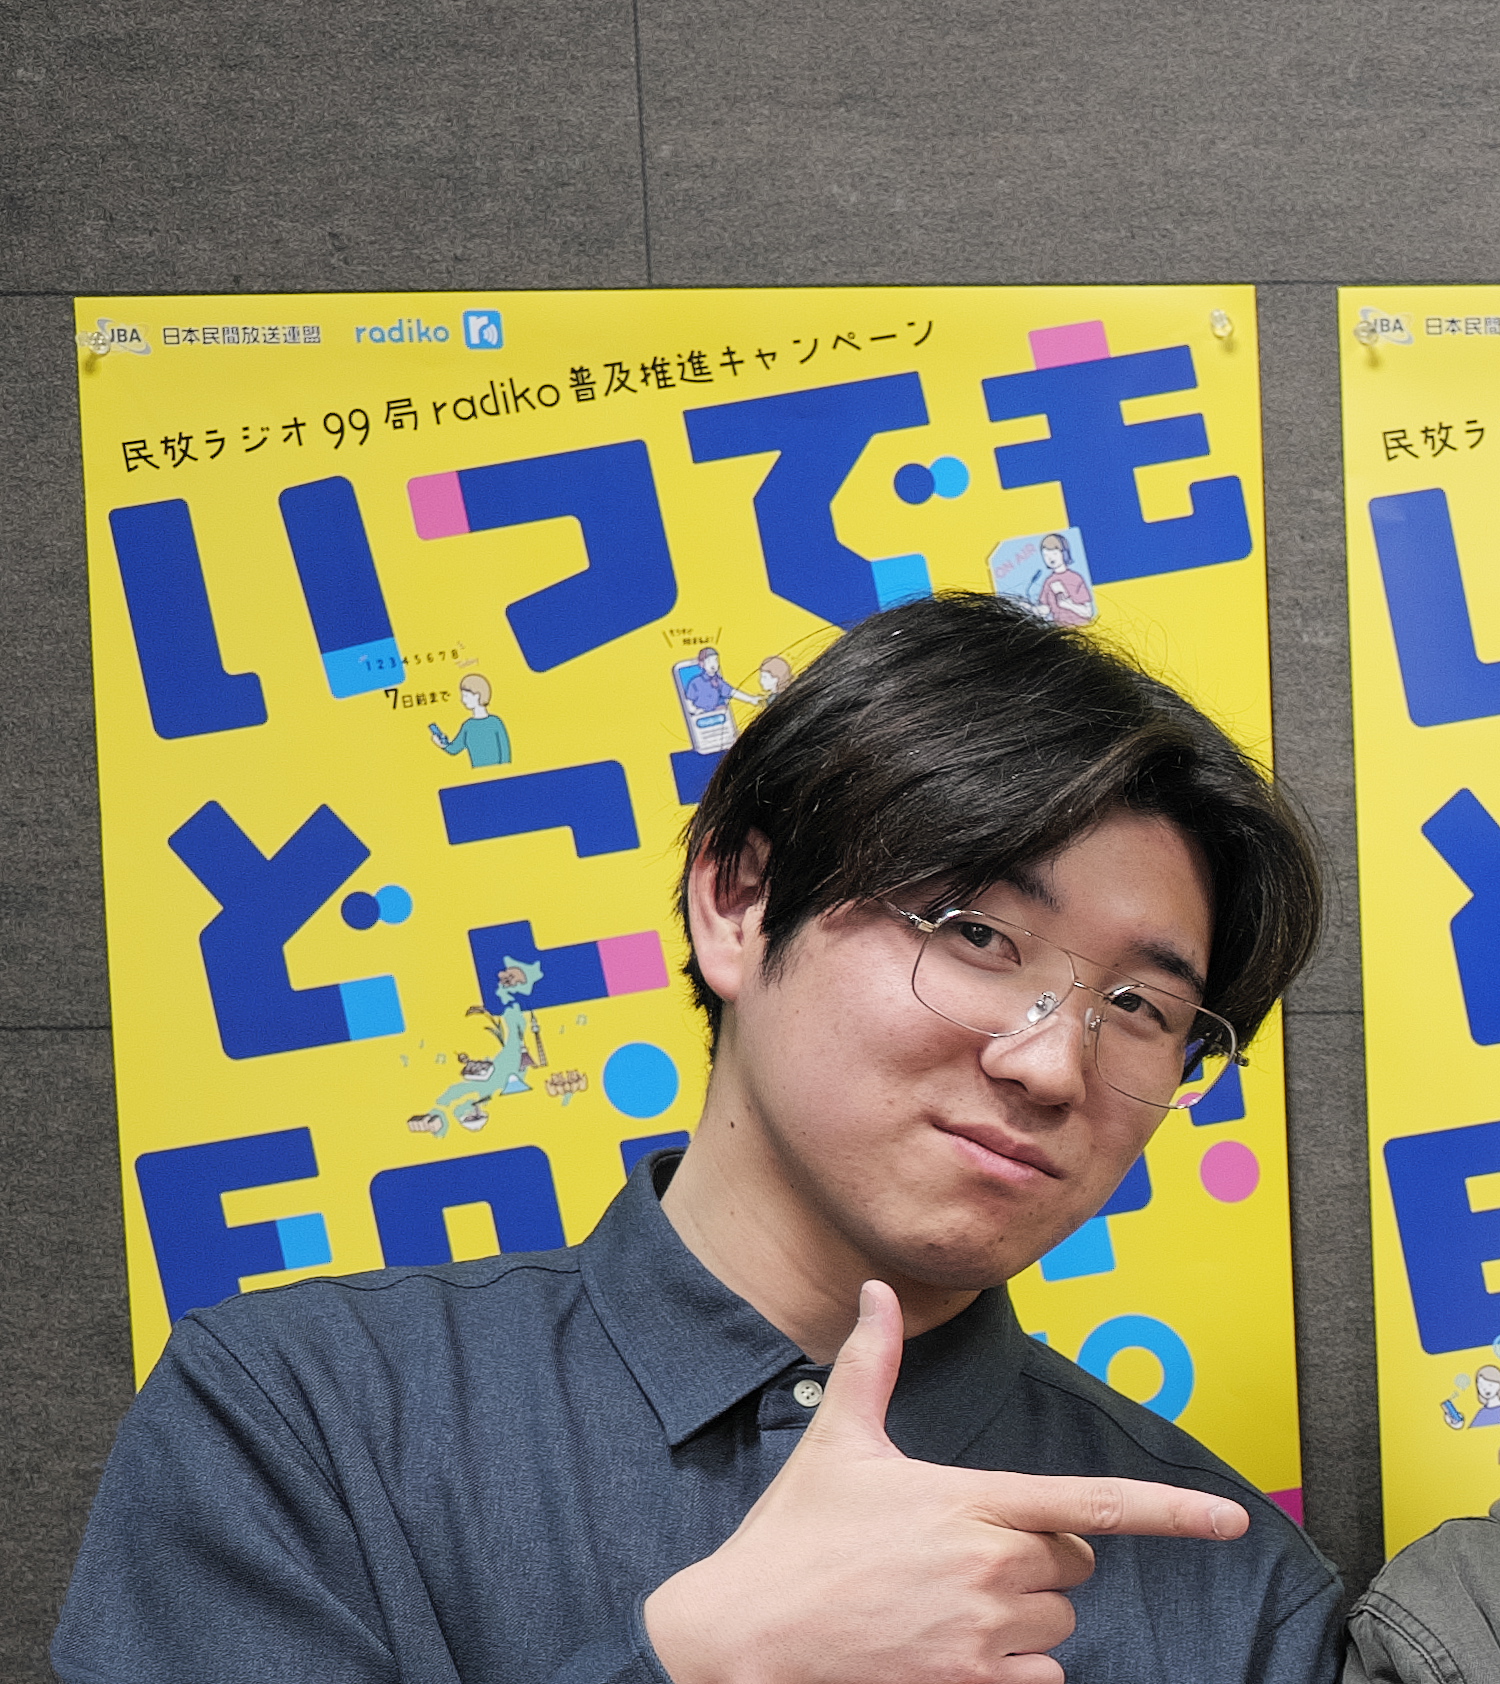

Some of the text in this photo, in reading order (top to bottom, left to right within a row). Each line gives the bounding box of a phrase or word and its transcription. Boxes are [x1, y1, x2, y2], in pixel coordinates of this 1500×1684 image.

[162, 325, 321, 346] 日本民間放送連盟
[354, 319, 449, 344] radiko
